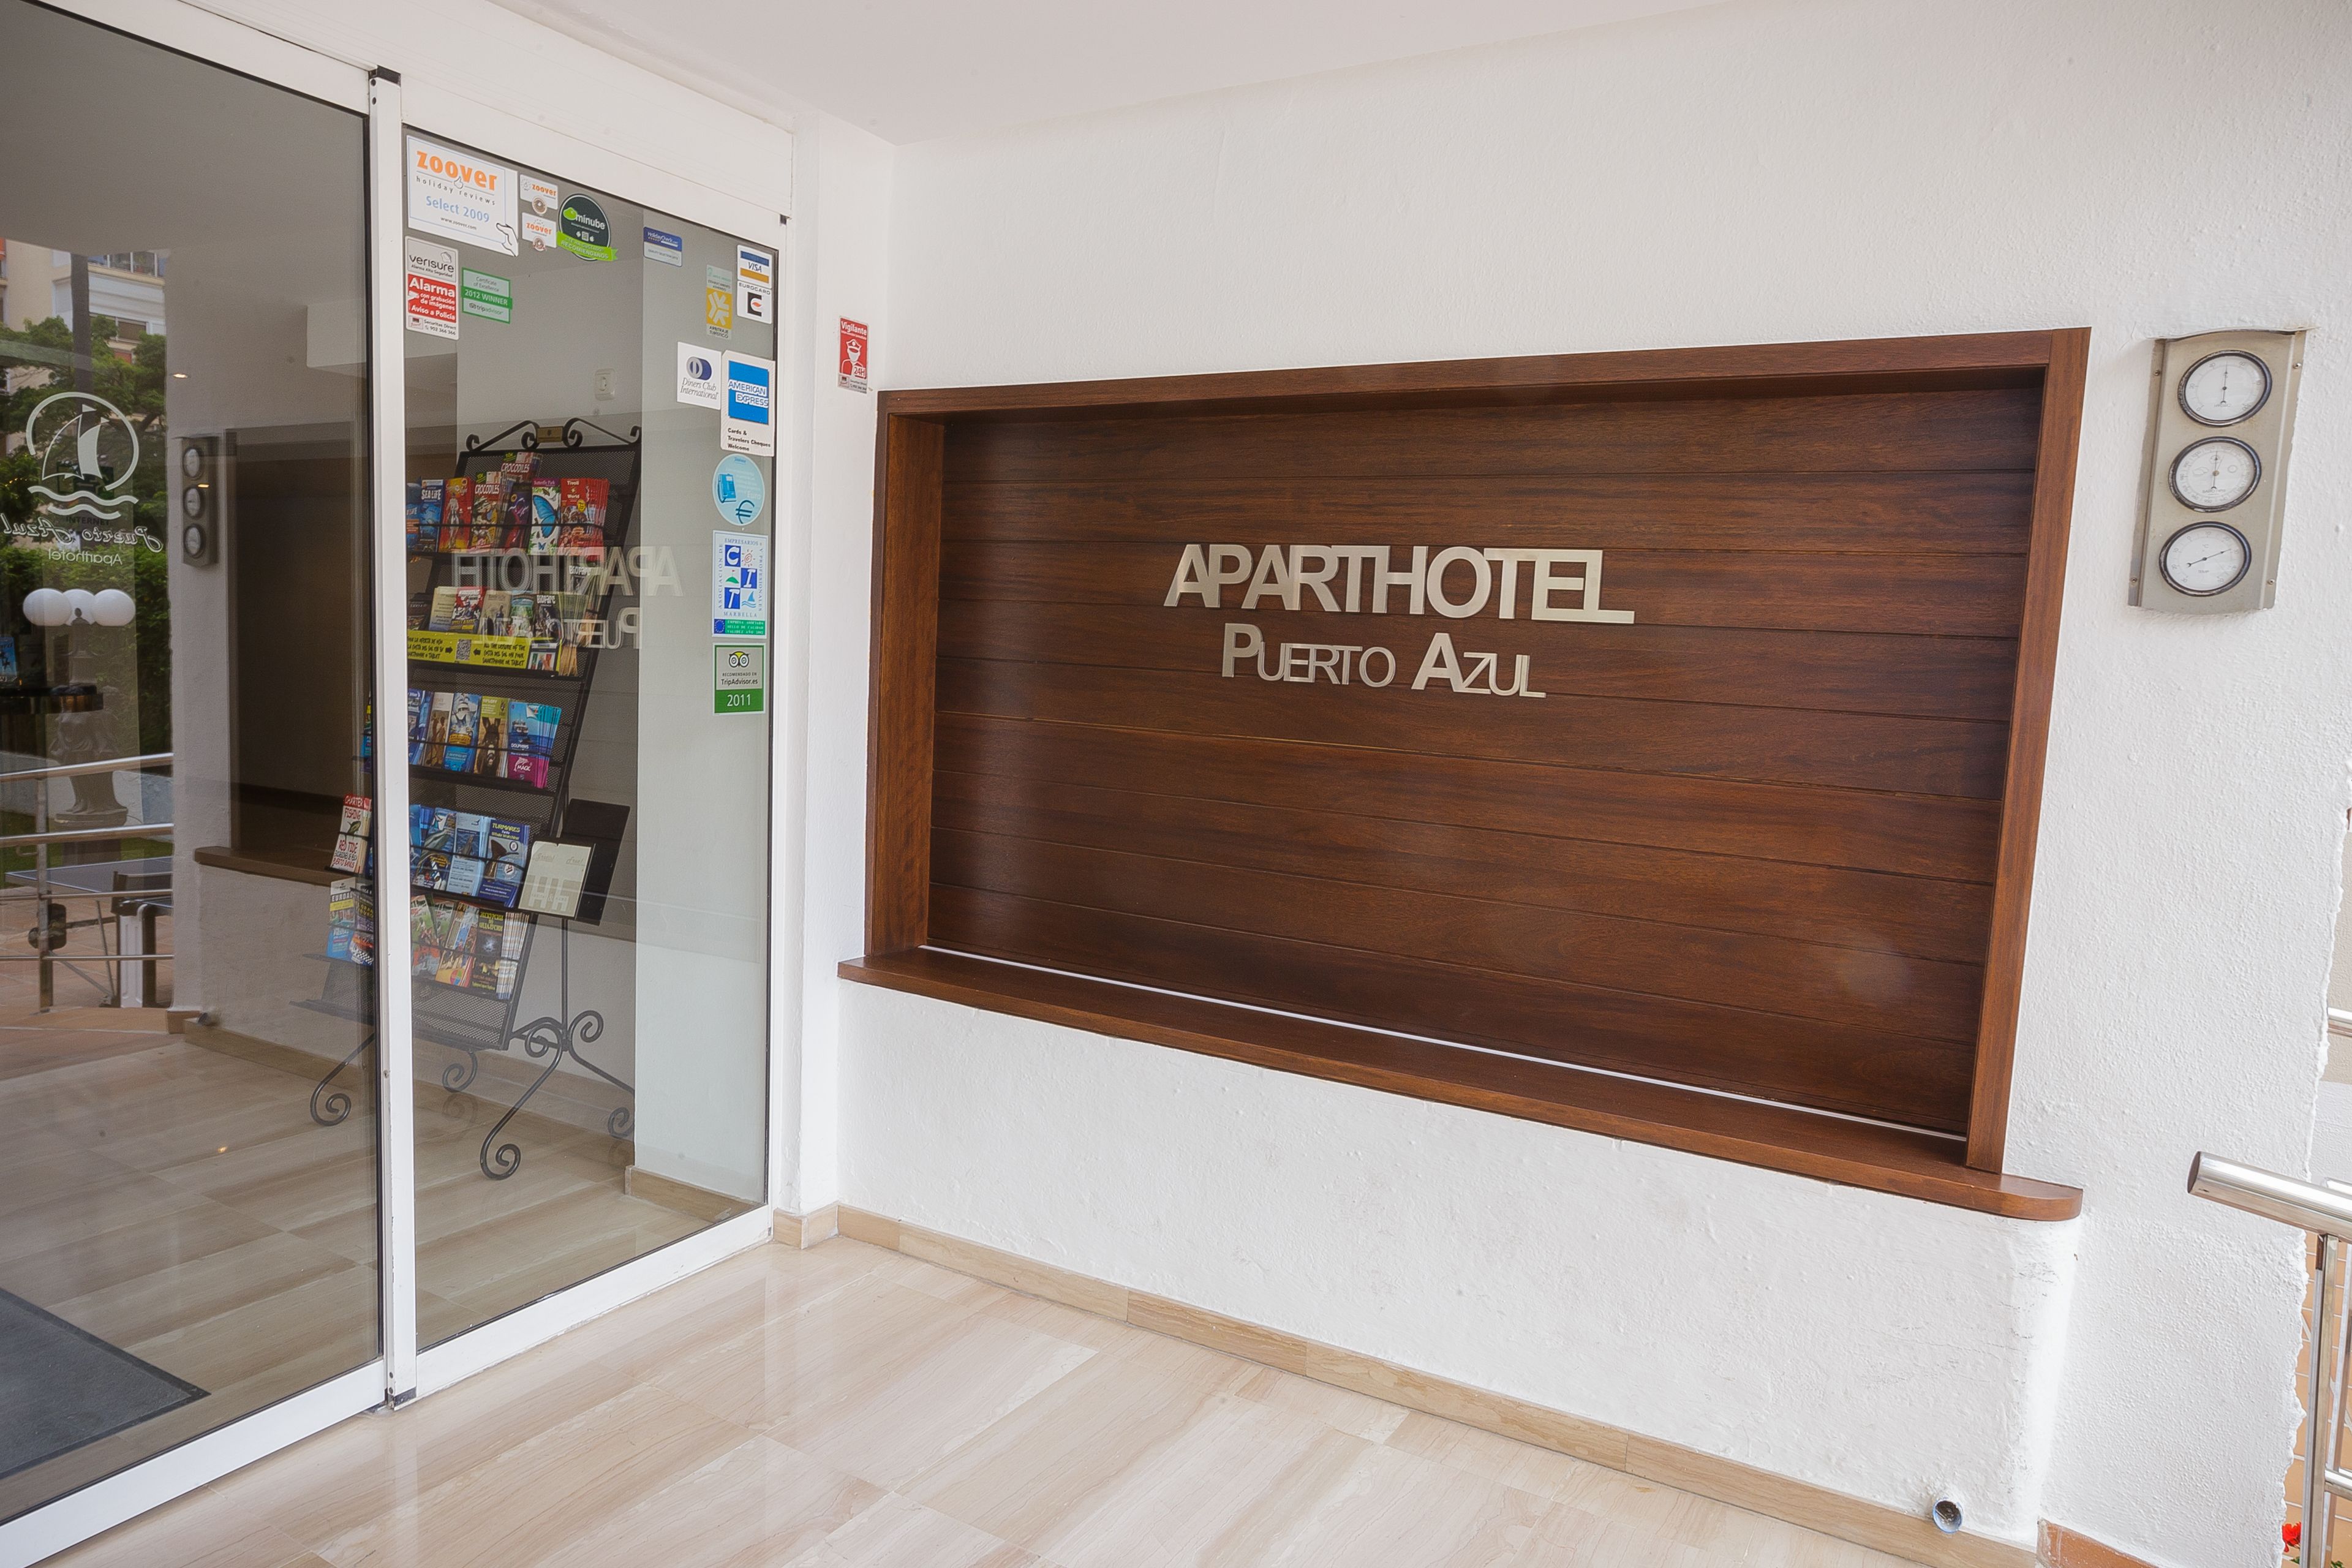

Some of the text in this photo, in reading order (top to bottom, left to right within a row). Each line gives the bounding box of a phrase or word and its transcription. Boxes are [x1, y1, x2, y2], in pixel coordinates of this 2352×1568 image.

[417, 151, 497, 190] zoover
[417, 176, 496, 206] holiday reviews
[532, 184, 557, 197] zoover
[426, 195, 490, 223] Select 2009
[440, 216, 477, 230] www.zoover.com
[526, 222, 552, 235] zoover
[409, 254, 454, 273] verisure
[748, 262, 762, 273] VISA
[434, 270, 453, 278] Seguridad
[409, 277, 455, 298] Alarma
[739, 283, 771, 295] EUROCARD
[430, 295, 455, 305] grabación
[464, 289, 508, 306] 2012 WINNER
[429, 300, 455, 311] imágenes
[475, 304, 503, 315] tripadvisor
[411, 305, 429, 314] Aviso
[435, 310, 455, 320] Policía
[841, 321, 867, 336] Vigilante
[854, 367, 866, 377] 24H
[682, 377, 717, 391] Diners Club
[728, 380, 766, 396] AMERICAN
[680, 385, 719, 400] International
[736, 394, 769, 407] EXPRESS
[728, 435, 750, 444] Travelers
[728, 443, 750, 451] Welcome
[501, 464, 530, 473] CROCODILES
[421, 489, 431, 500] SEA
[431, 489, 442, 500] LIFE
[475, 484, 500, 495] CROCODILES
[726, 546, 740, 565] C
[743, 569, 756, 588] I
[1163, 543, 1635, 624] APARTHOTEL
[728, 589, 740, 608] T
[1222, 623, 1547, 698] PUERTO AZUL
[721, 678, 758, 687] TripAdvisor.es
[727, 694, 751, 707] 2011
[345, 795, 363, 808] CHARTER
[344, 807, 361, 820] FISHING
[492, 823, 520, 832] TURMARES
